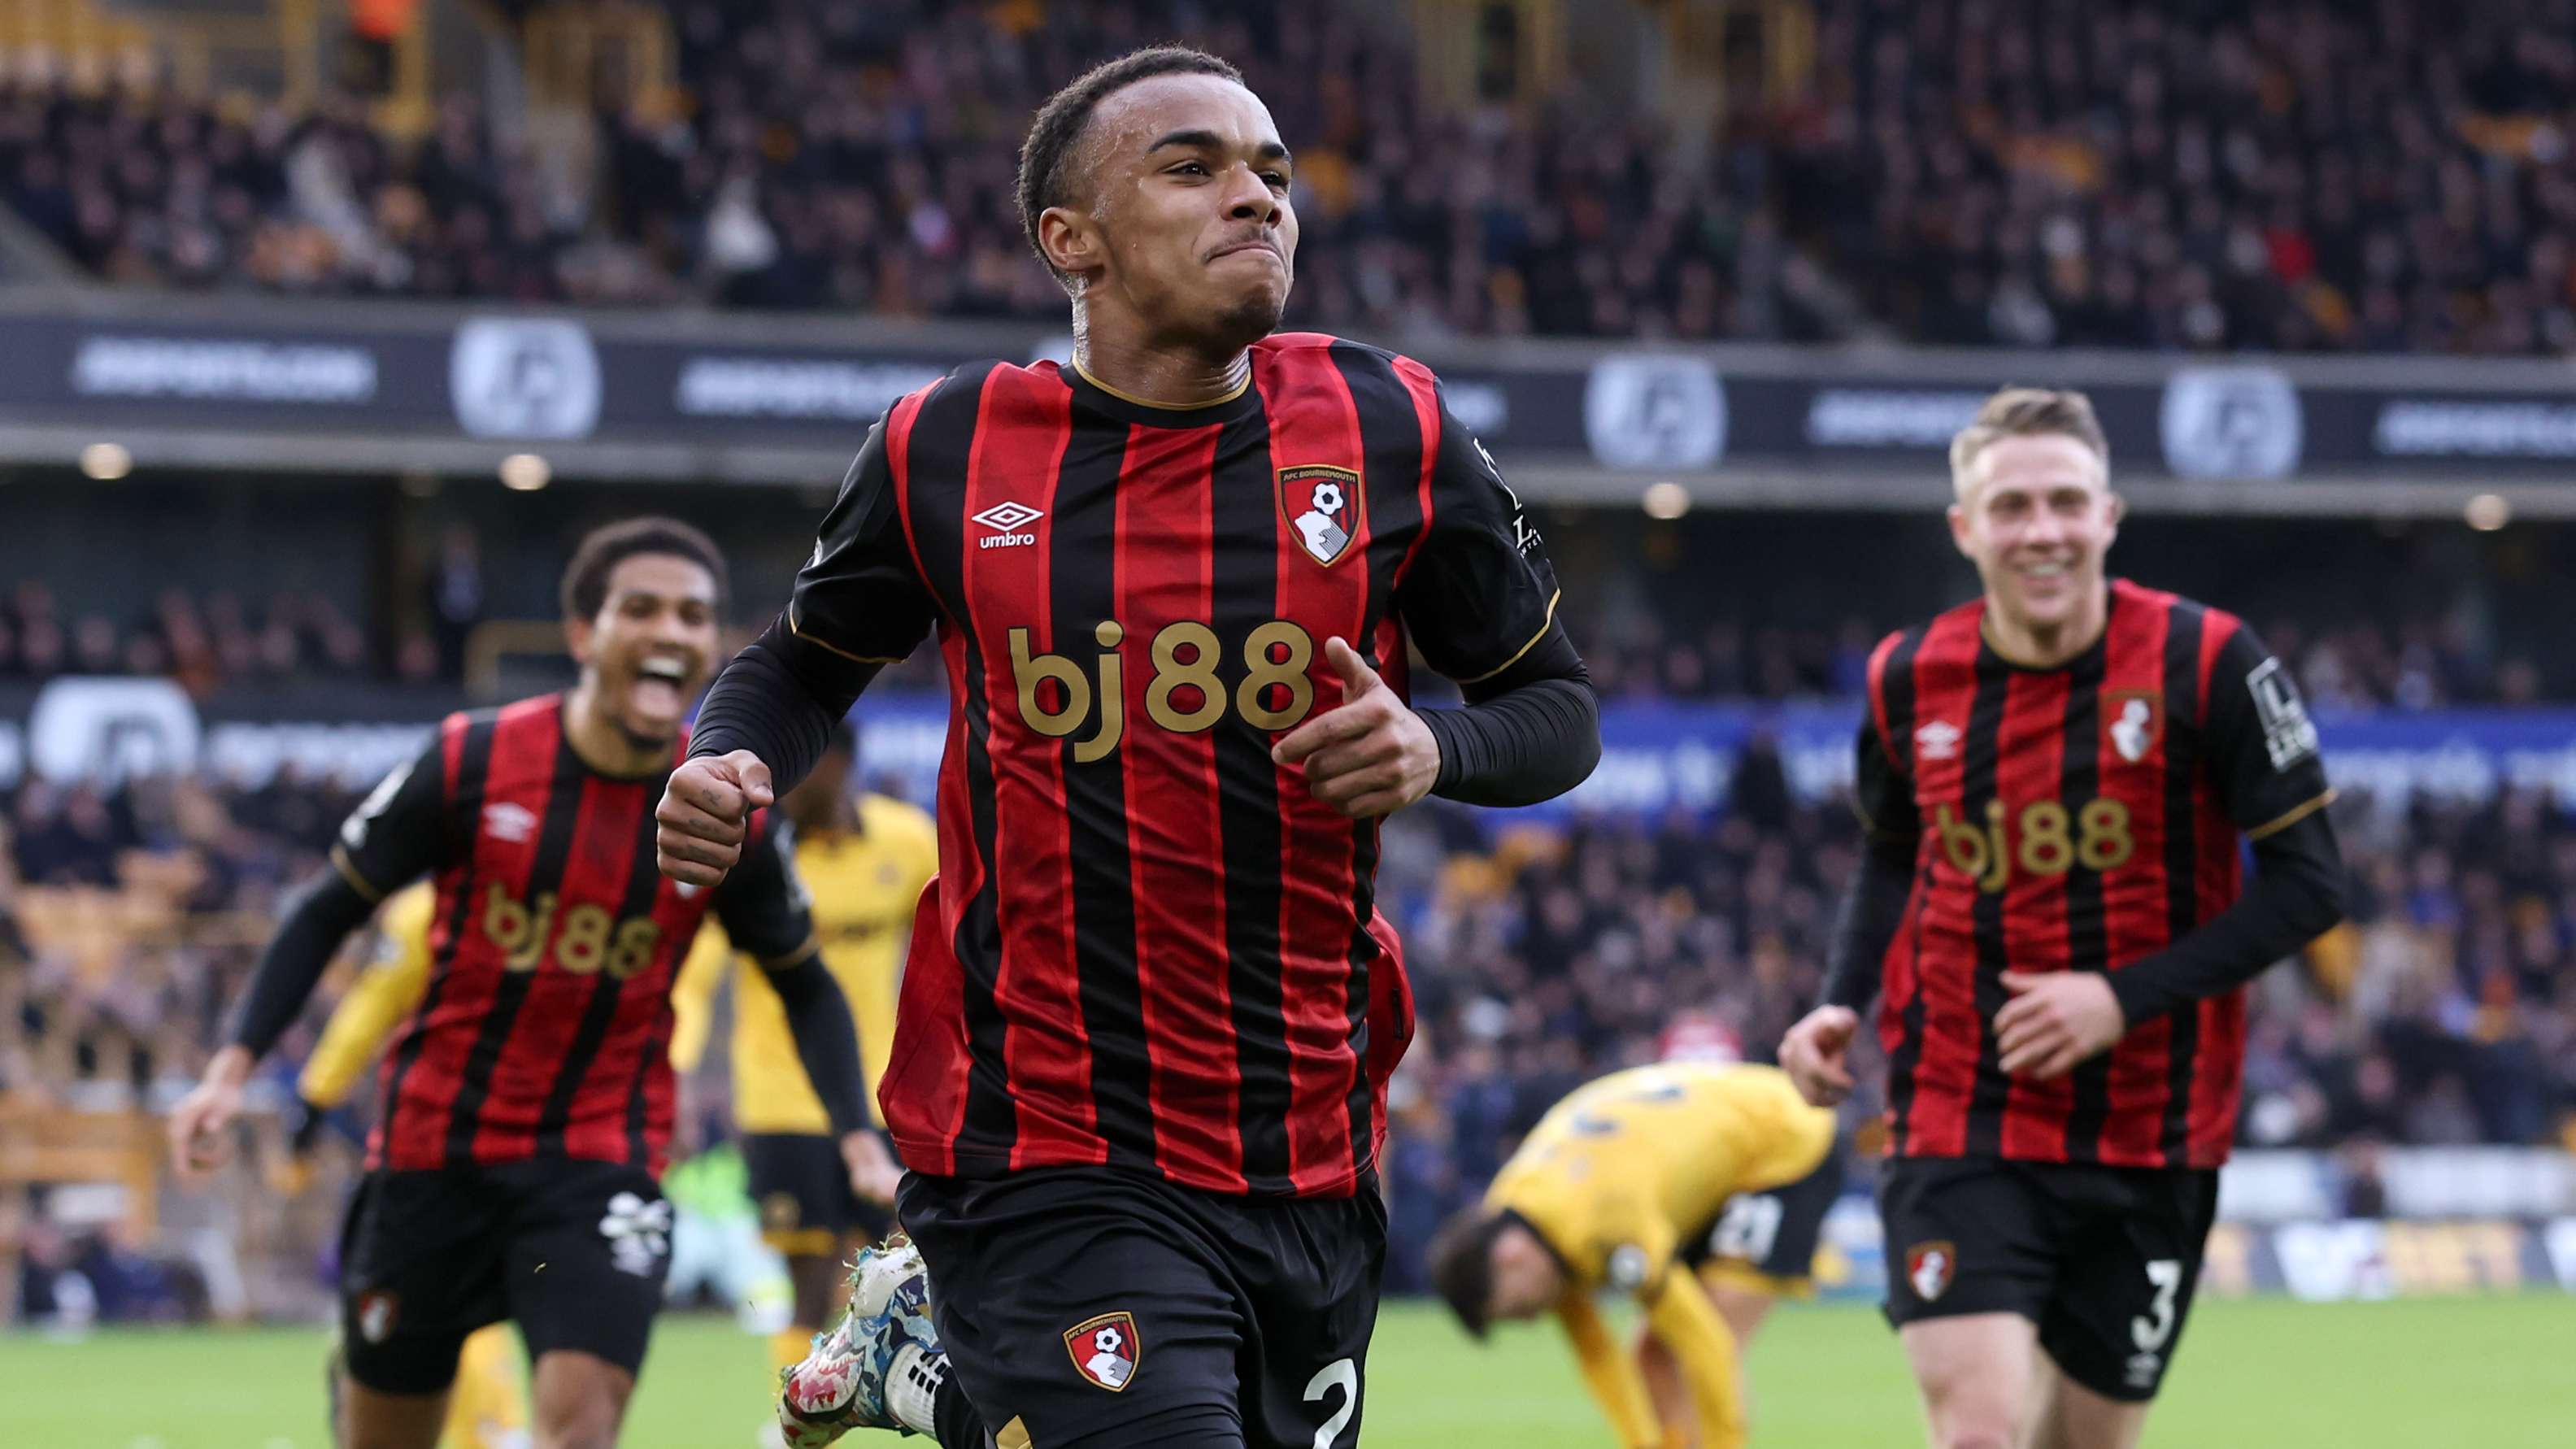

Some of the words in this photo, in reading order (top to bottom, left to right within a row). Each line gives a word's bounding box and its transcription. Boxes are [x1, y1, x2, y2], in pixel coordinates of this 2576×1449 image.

[1283, 472, 1299, 481] AFC
[1299, 469, 1355, 483] BOURNEMOUTH
[980, 532, 1034, 549] umbro
[1008, 620, 1314, 763] bj88
[1937, 797, 2134, 892] bj88
[2130, 1260, 2182, 1354] 3
[1303, 1357, 1359, 1449] 2
